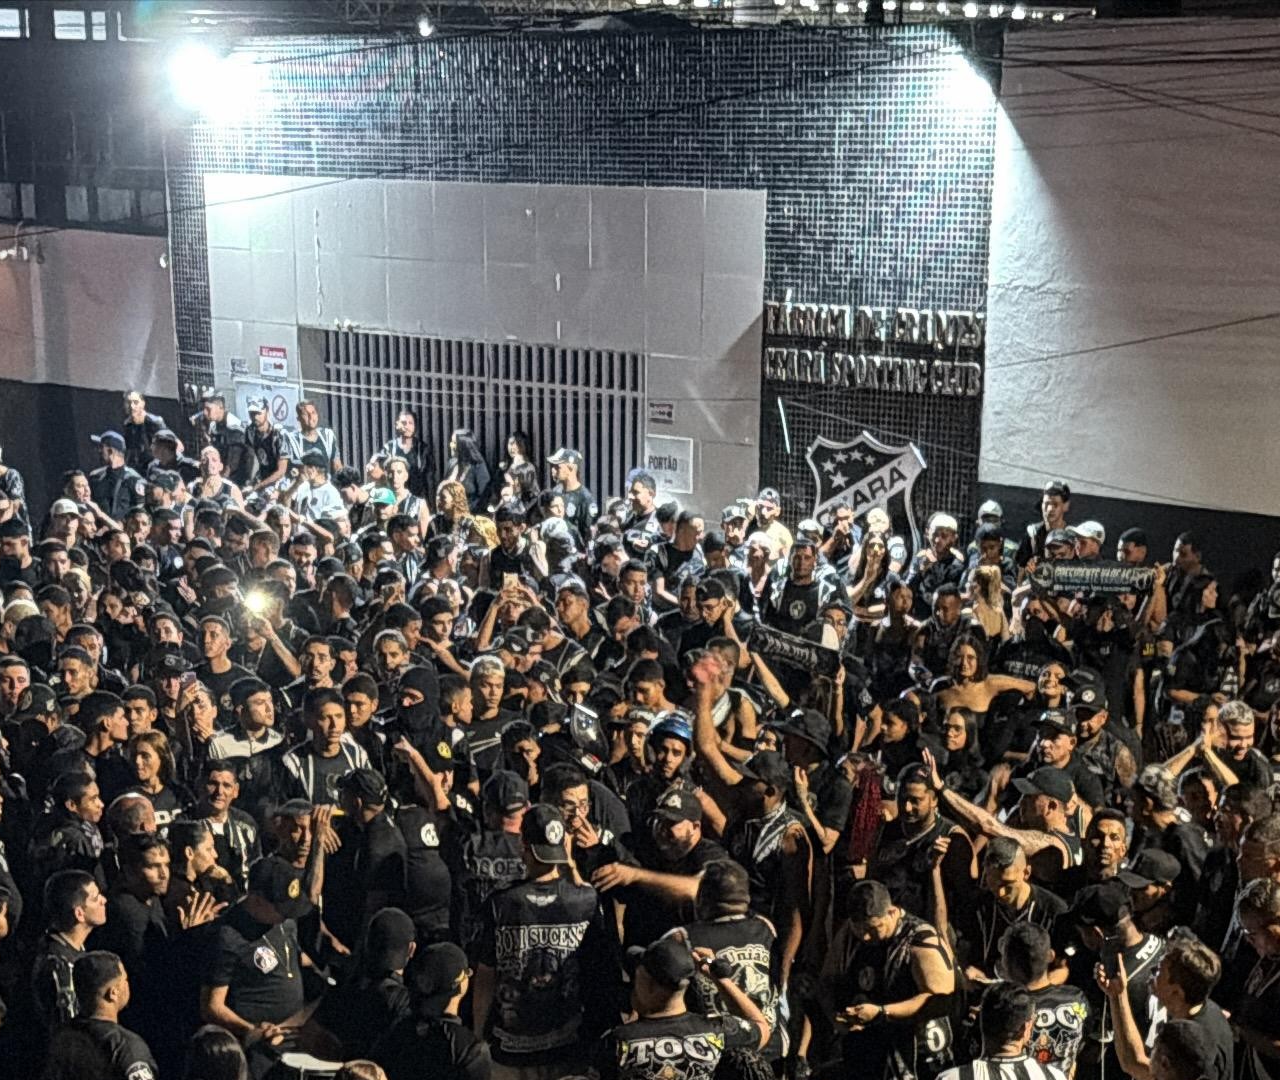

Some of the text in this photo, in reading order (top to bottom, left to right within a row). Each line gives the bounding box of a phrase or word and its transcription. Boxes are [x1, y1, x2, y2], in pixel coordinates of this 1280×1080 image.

[832, 352, 928, 393] SPORTING
[931, 360, 982, 397] CLUB
[649, 455, 678, 471] PORTÃO
[628, 1036, 717, 1067] TOC
